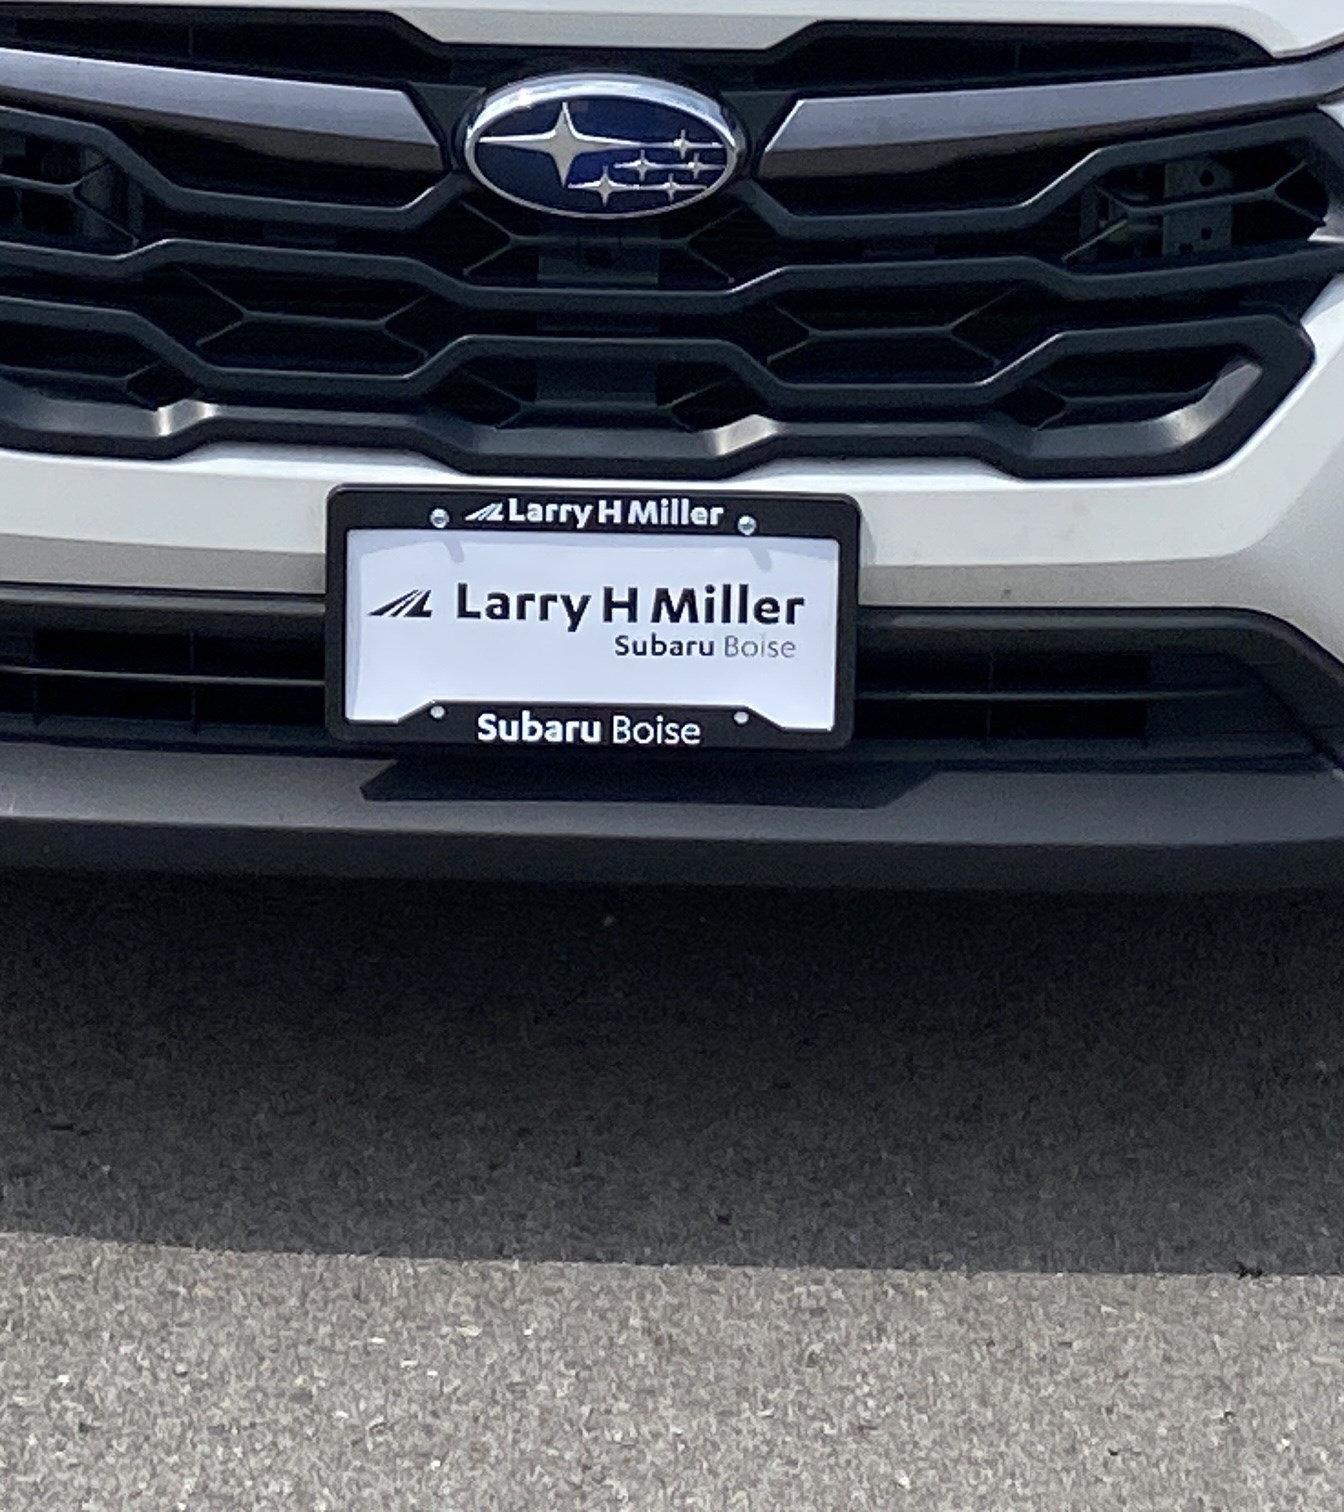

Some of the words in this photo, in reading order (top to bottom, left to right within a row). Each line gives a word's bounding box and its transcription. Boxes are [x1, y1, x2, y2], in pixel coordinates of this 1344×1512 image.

[508, 498, 593, 529] Larry
[598, 500, 623, 525] H
[627, 498, 724, 526] Miller
[456, 583, 591, 632] Larry
[603, 587, 638, 624] H
[650, 584, 805, 626] Miller
[614, 633, 714, 657] Subaru
[724, 634, 797, 659] Boise
[477, 711, 601, 743] Subaru
[612, 715, 701, 745] Boise
